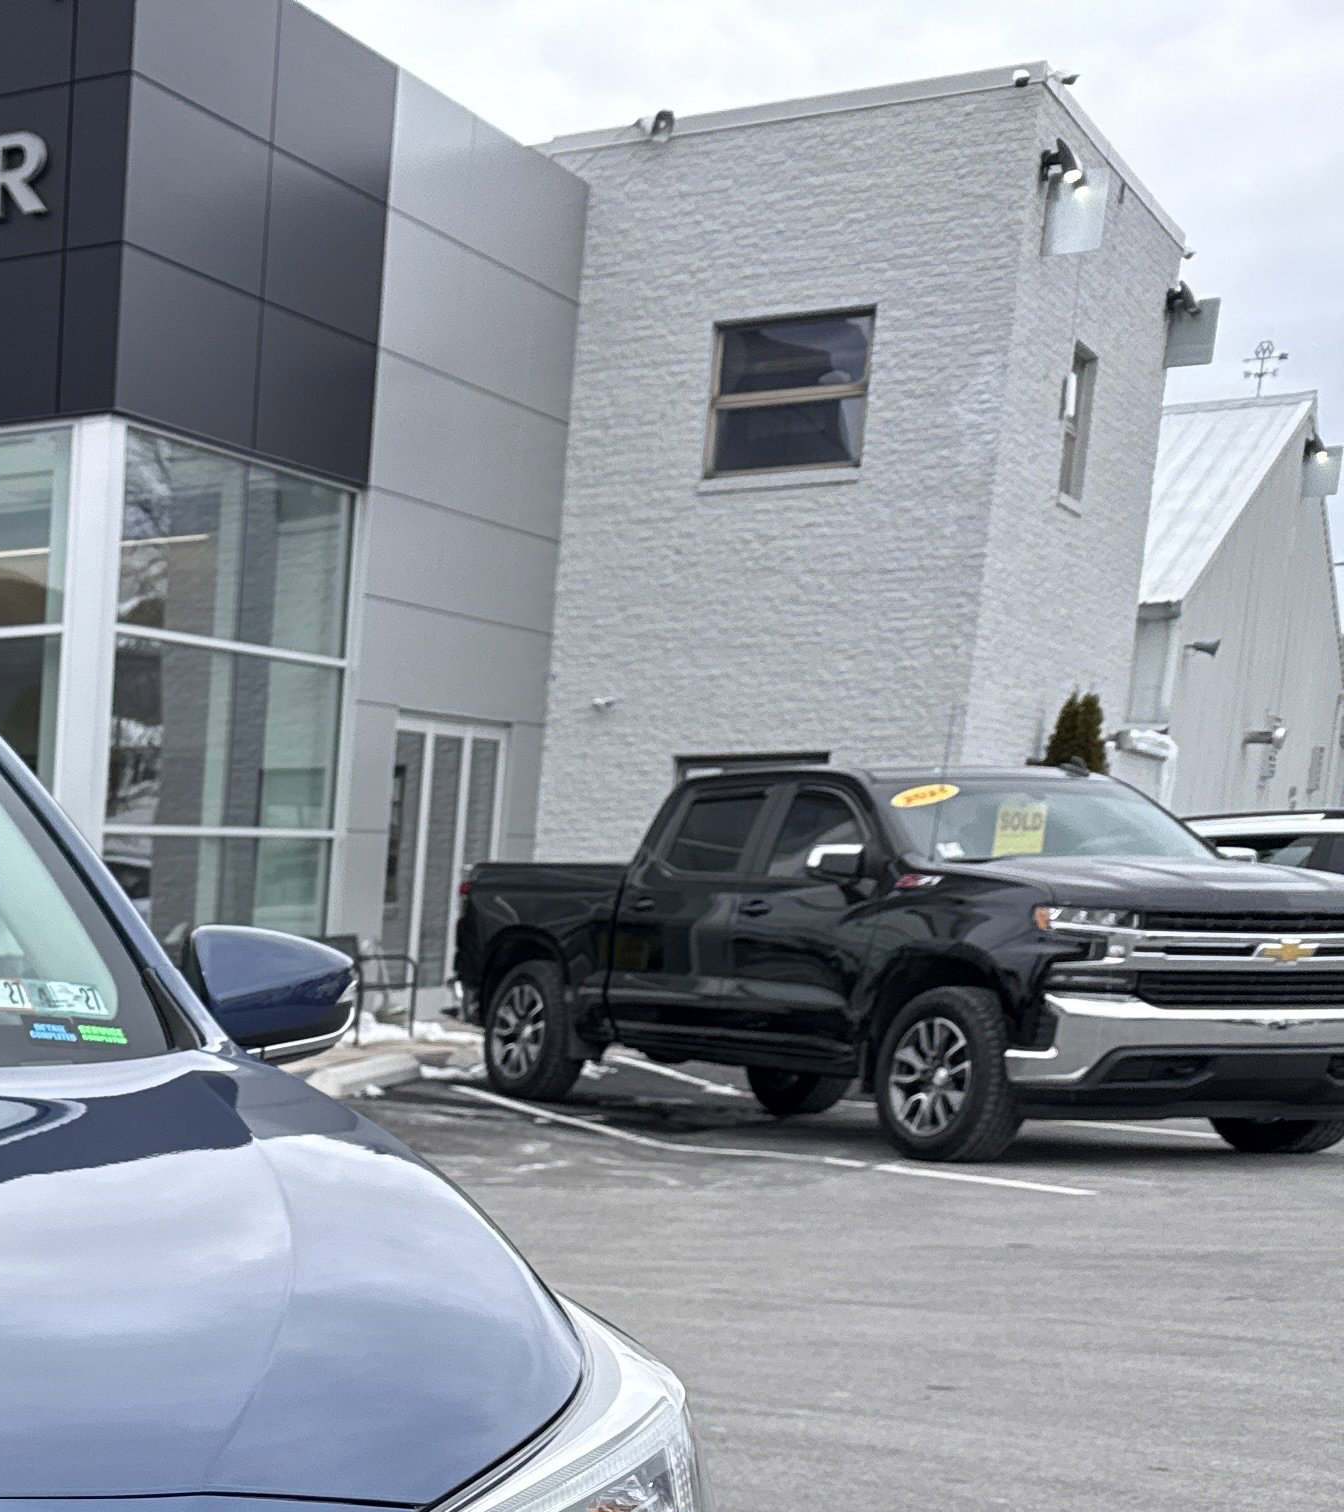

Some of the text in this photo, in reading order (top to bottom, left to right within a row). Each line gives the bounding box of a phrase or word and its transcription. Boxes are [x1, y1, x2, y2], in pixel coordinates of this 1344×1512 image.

[999, 811, 1043, 831] SOLD
[3, 981, 25, 1007] 27
[79, 987, 102, 1011] 27
